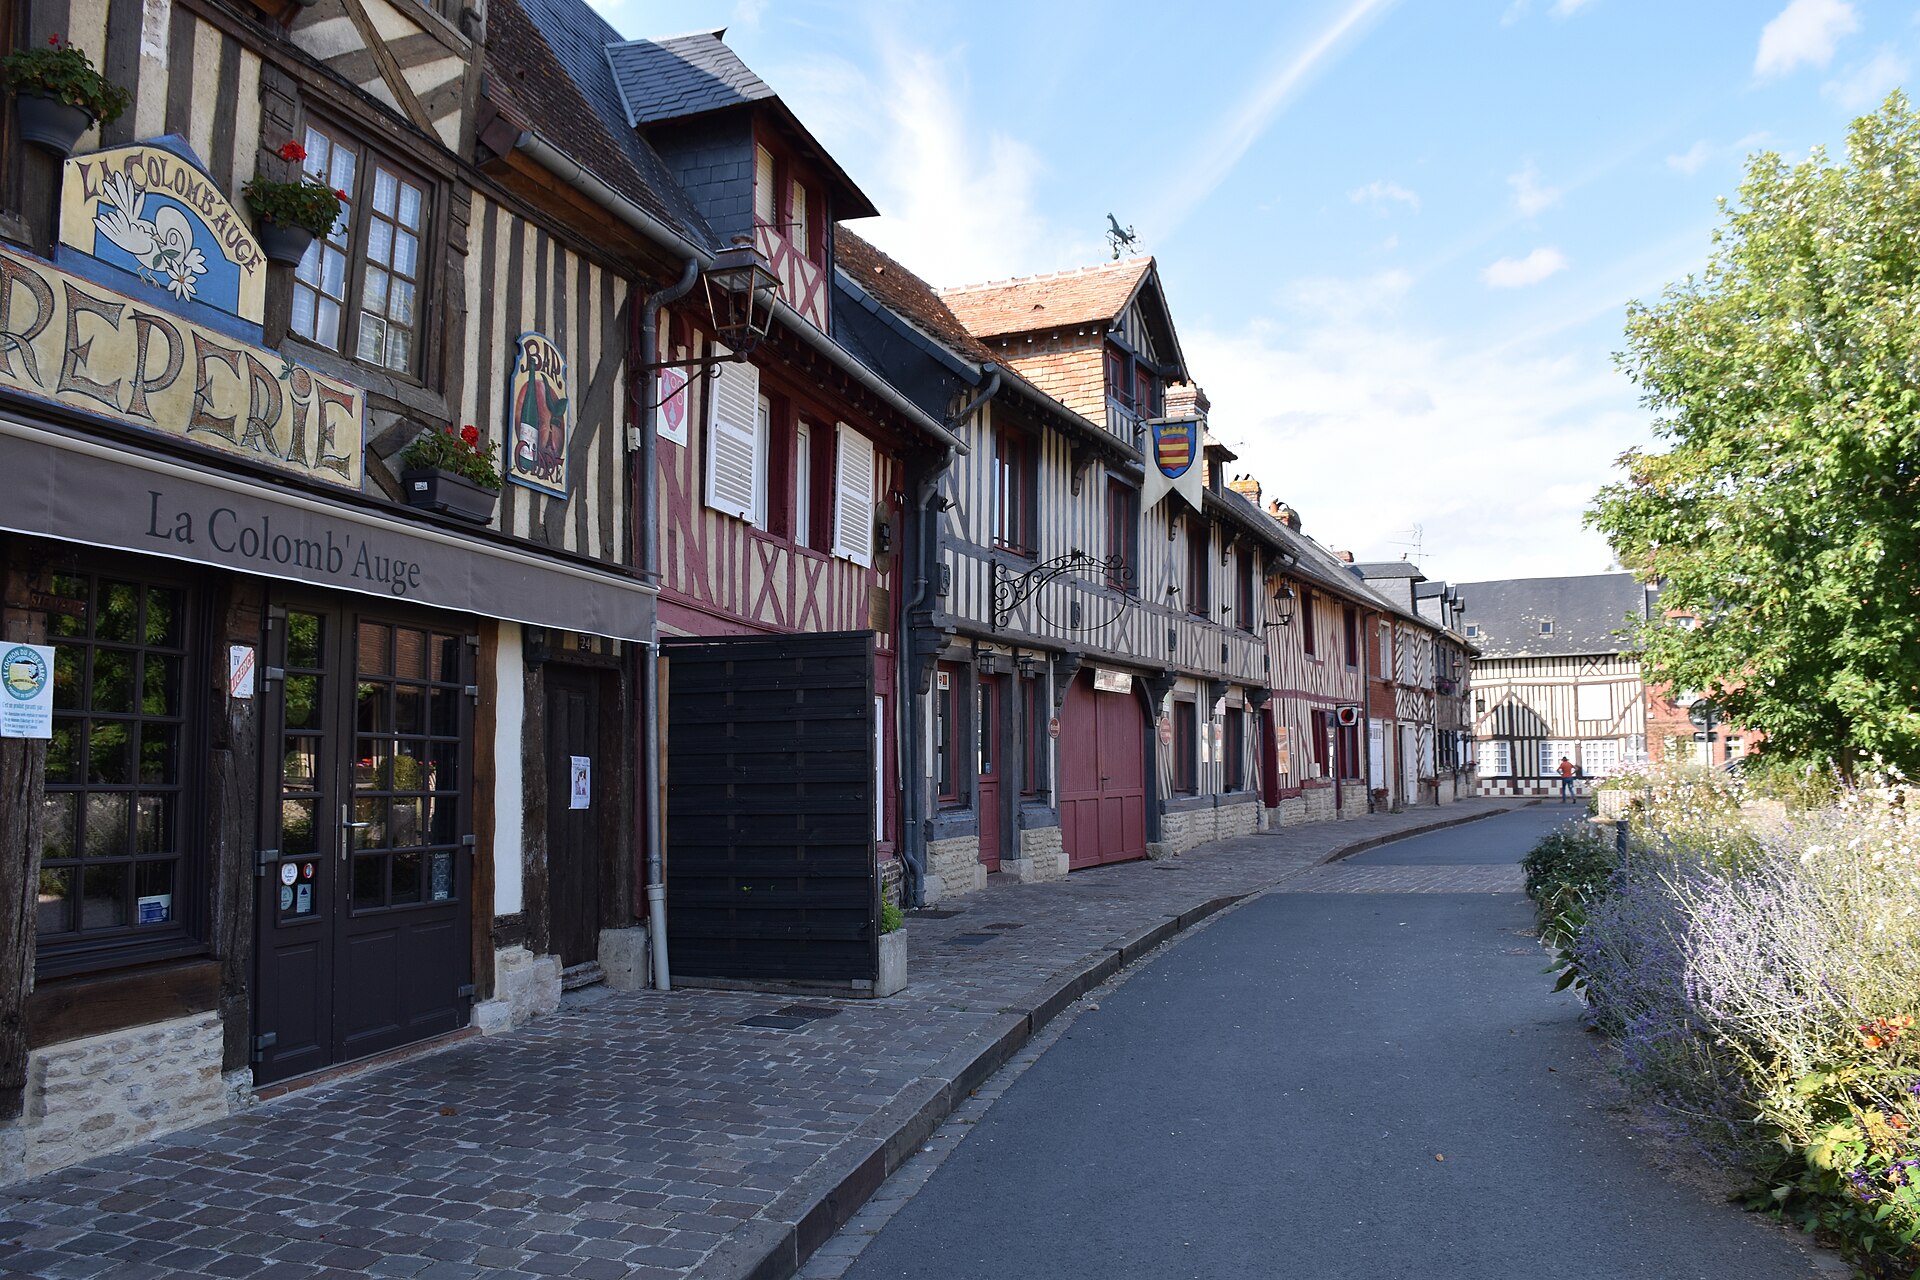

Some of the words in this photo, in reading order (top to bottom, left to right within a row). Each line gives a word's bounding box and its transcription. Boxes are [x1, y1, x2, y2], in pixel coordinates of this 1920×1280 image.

[124, 149, 263, 277] COLOMB'AUGE
[520, 338, 562, 390] BAR
[145, 490, 195, 544] La
[207, 507, 421, 596] Colomb'Auge
[580, 635, 591, 650] 24
